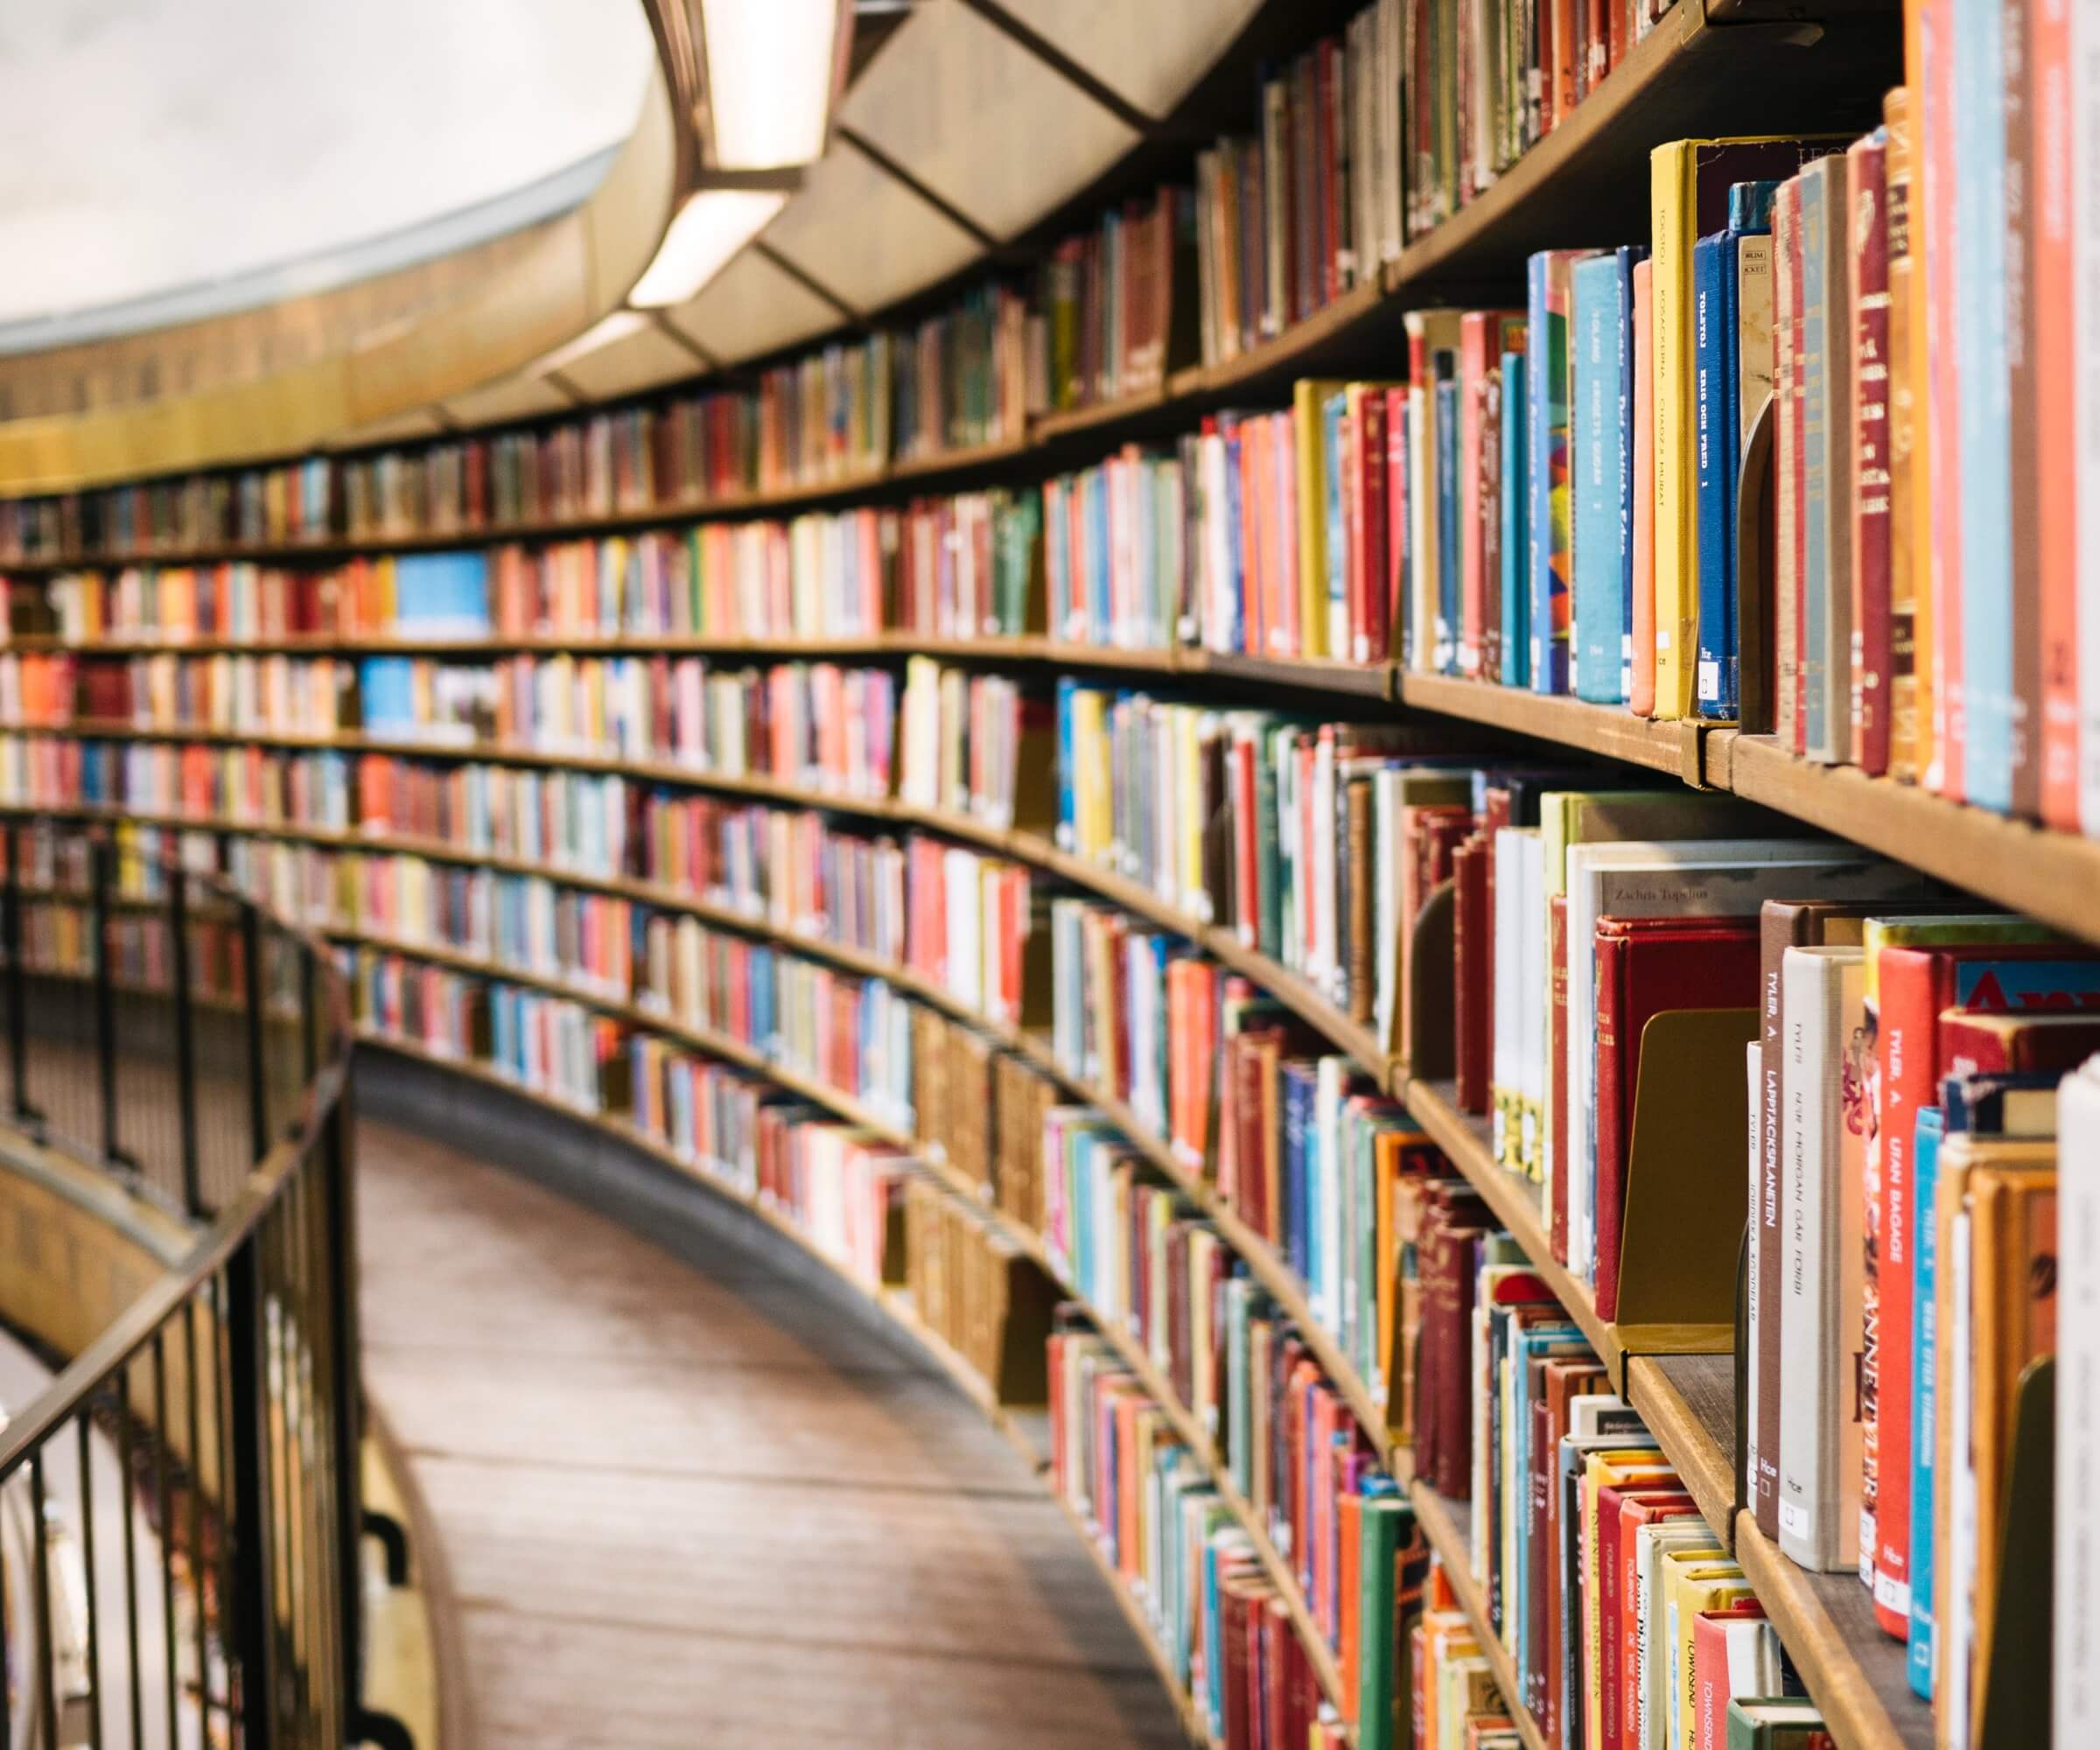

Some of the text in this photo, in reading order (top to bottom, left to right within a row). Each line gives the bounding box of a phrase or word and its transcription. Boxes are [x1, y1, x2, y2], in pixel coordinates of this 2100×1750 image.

[1616, 887, 1709, 903] Zachris Topelius
[1767, 971, 1777, 1019] TYLER,
[1889, 1029, 1902, 1082] TYLER,
[1889, 1138, 1902, 1183] UTAN
[1889, 1189, 1902, 1263] BAGAGE
[1862, 1287, 1880, 1497] ANNE TYLER
[1704, 1680, 1713, 1750] TOWNSEND
